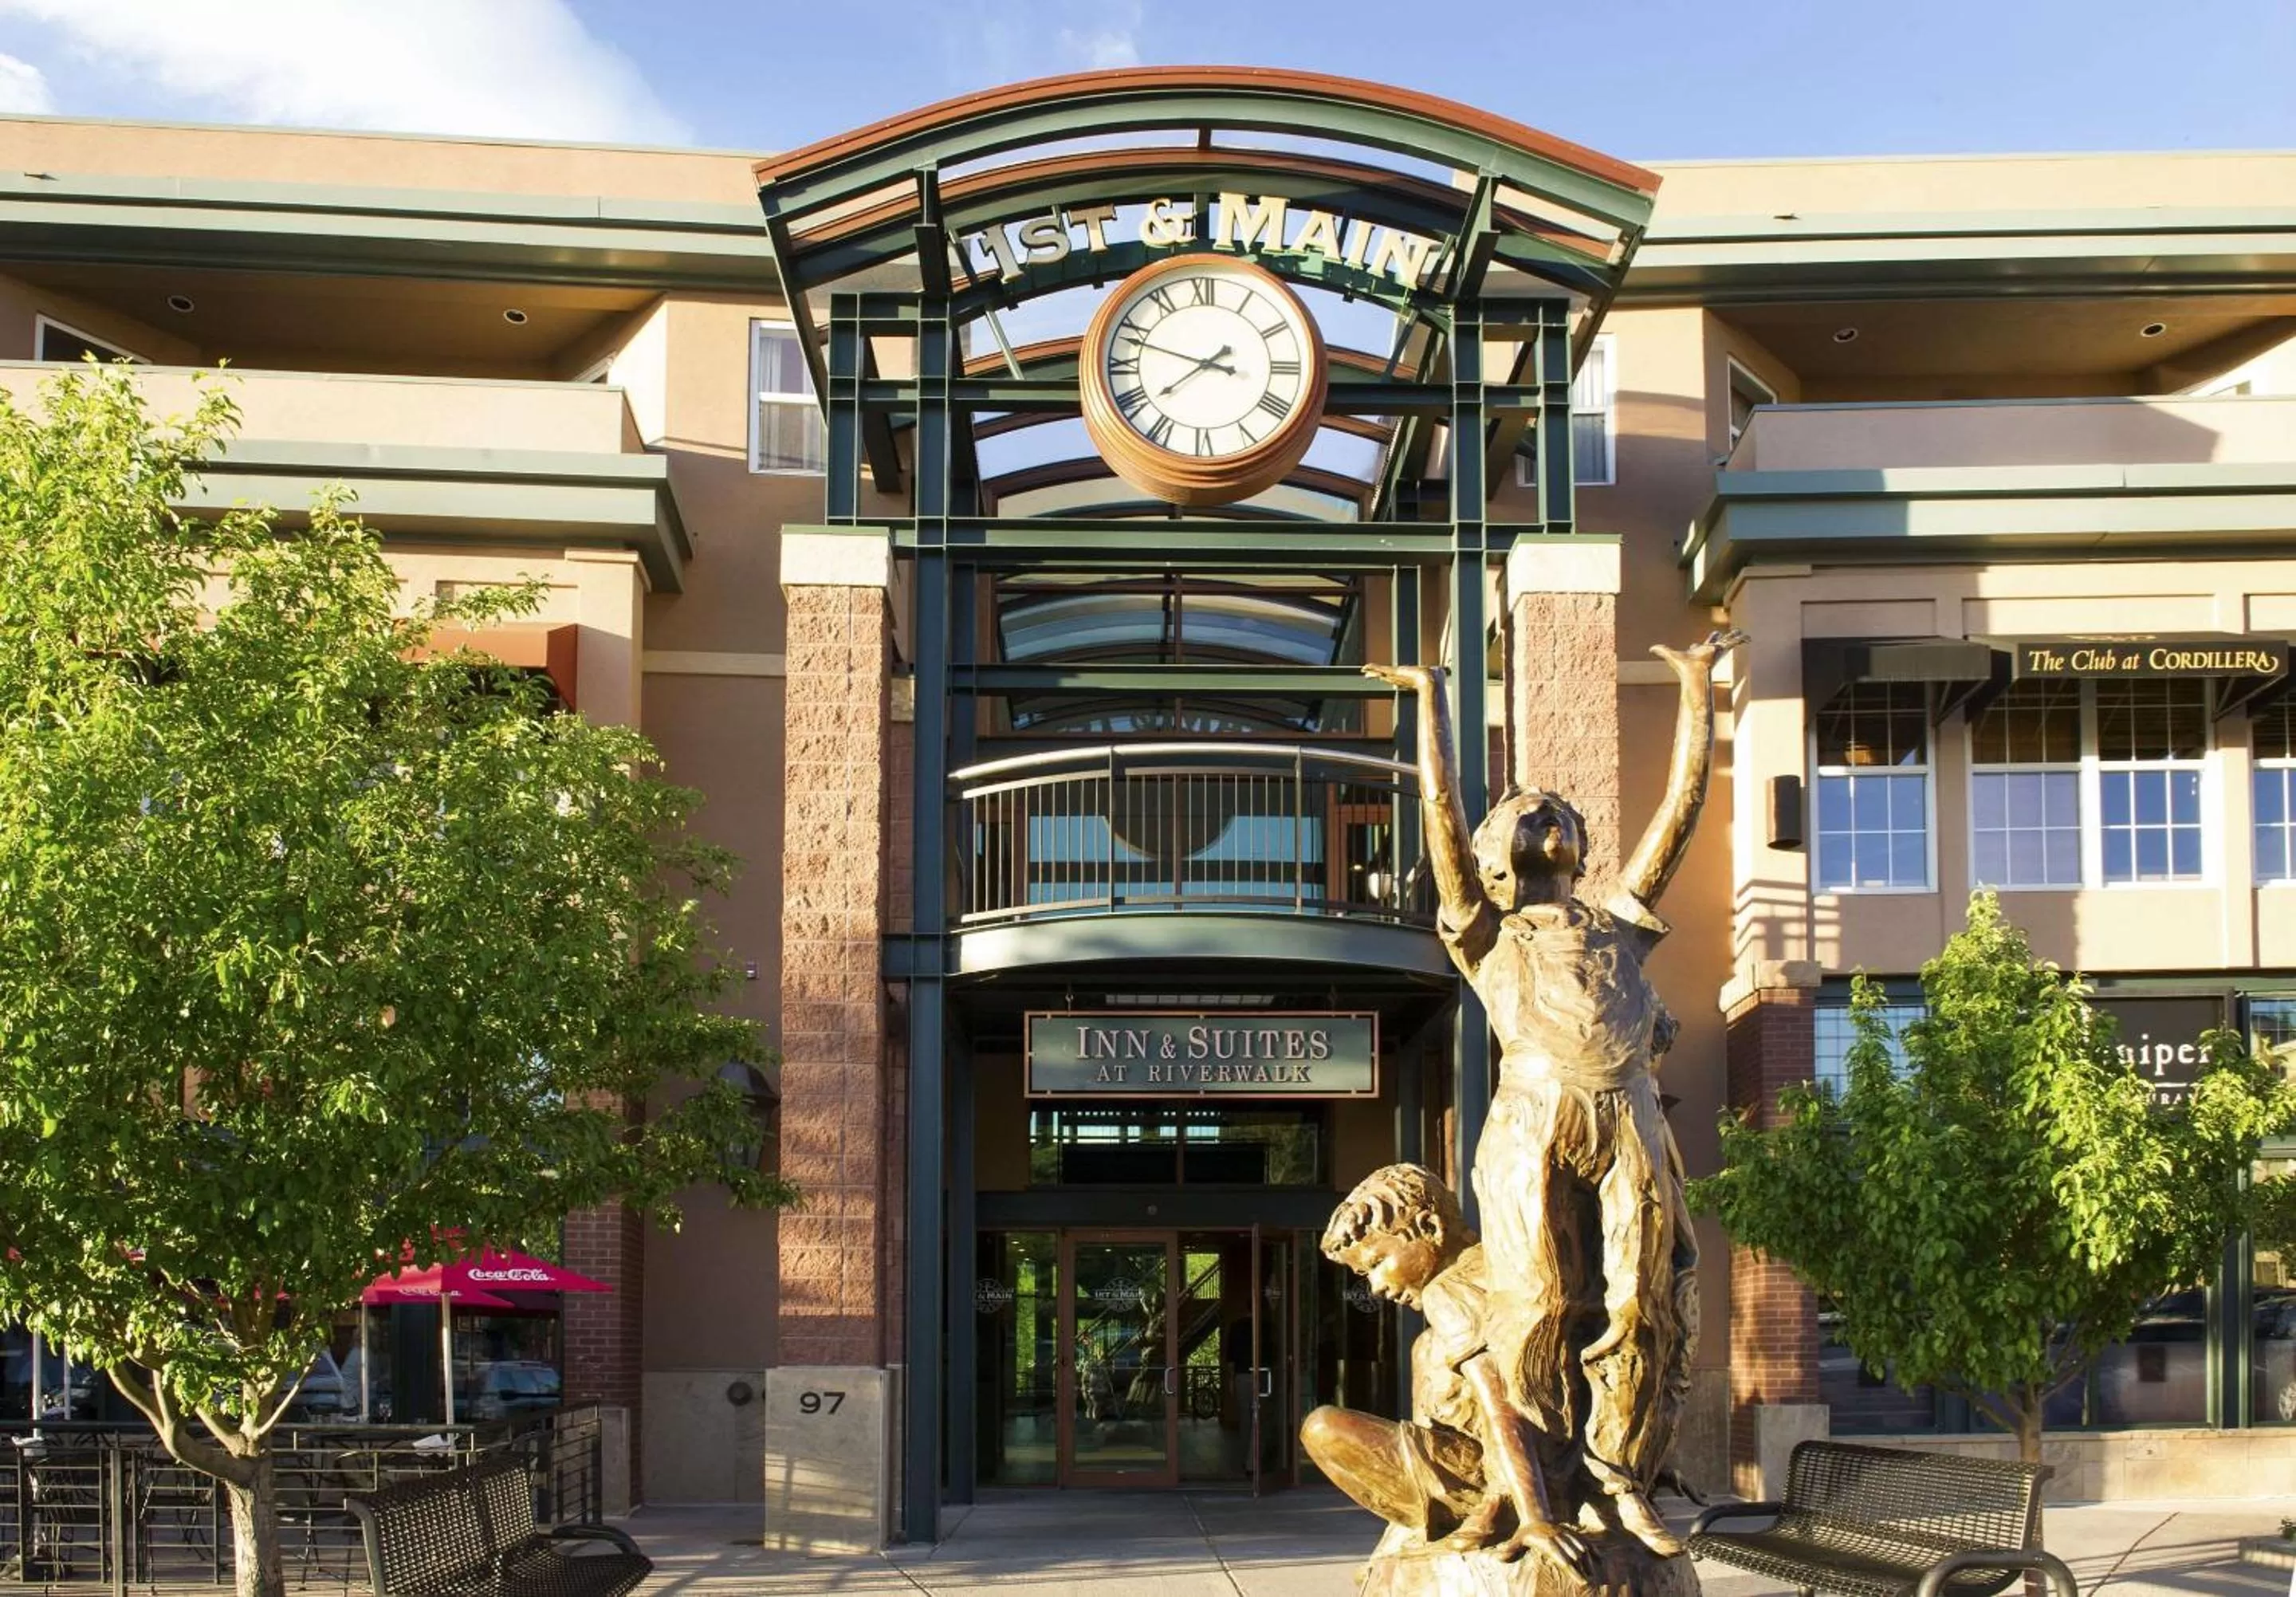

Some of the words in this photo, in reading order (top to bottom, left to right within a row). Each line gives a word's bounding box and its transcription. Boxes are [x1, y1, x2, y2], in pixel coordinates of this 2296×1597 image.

[979, 204, 1116, 284] 1ST
[1140, 198, 1197, 249] &
[1213, 191, 1440, 290] MAIN
[2029, 650, 2065, 671] The
[2071, 648, 2116, 671] Club
[2121, 652, 2141, 671] at
[2149, 648, 2278, 673] CORDILLERA
[1077, 1026, 1150, 1060] INN
[1159, 1033, 1177, 1060] &
[1187, 1025, 1330, 1060] SUITES
[1097, 1064, 1128, 1082] AT
[1148, 1064, 1312, 1083] RIVERWALK
[467, 1269, 556, 1281] Coca-Cola
[800, 1391, 846, 1414] 97
